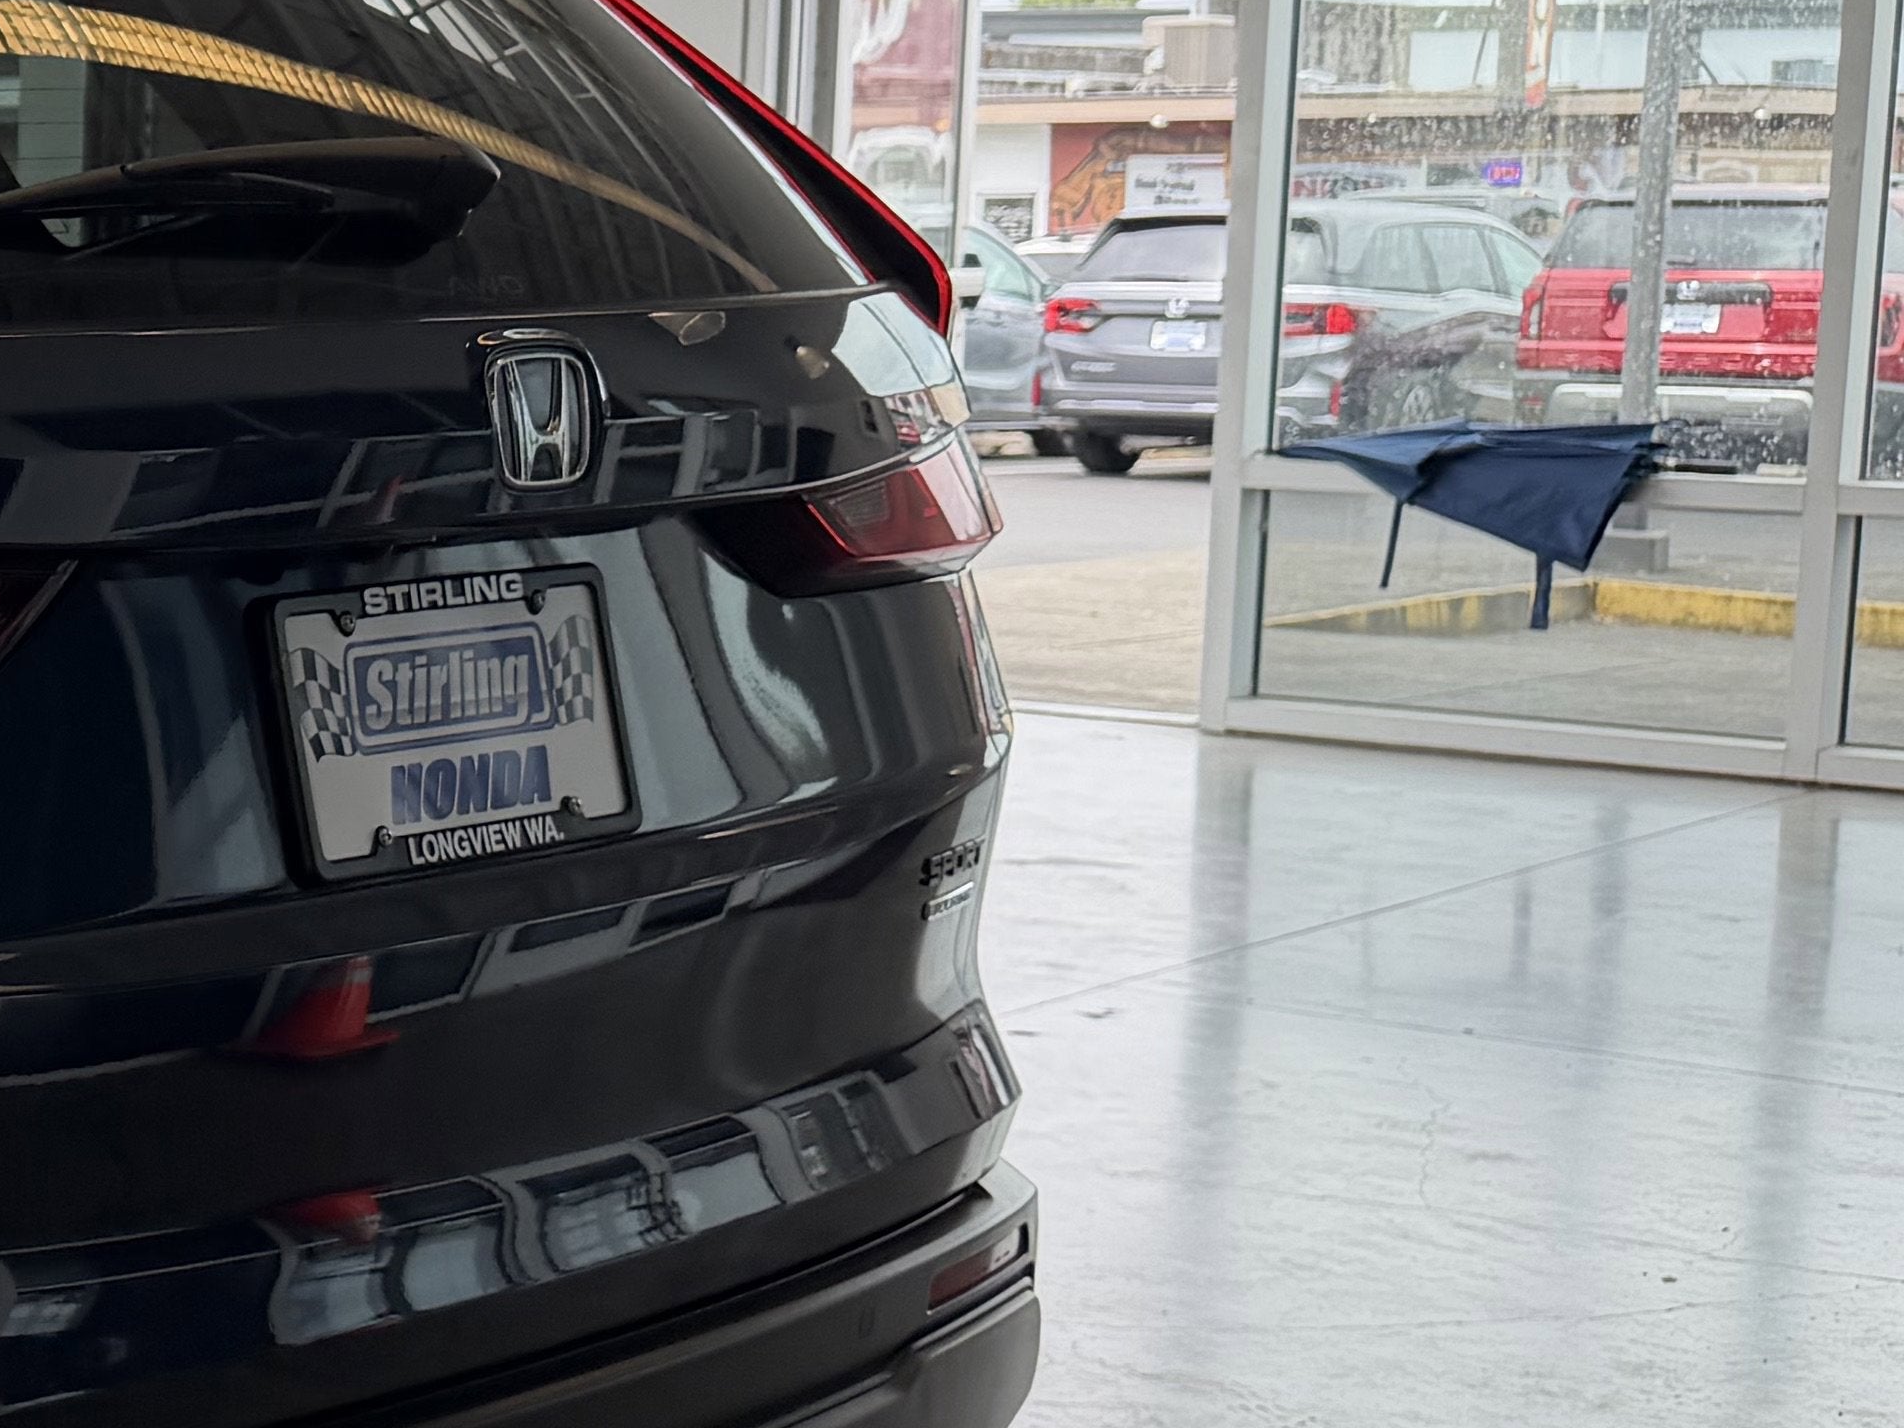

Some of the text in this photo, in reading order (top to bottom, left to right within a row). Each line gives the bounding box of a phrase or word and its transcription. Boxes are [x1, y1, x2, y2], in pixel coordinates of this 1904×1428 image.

[363, 572, 523, 615] STIRLING
[365, 649, 529, 730] Stirling
[391, 744, 552, 825] HONDA
[408, 816, 565, 865] LONGVIEW WA.
